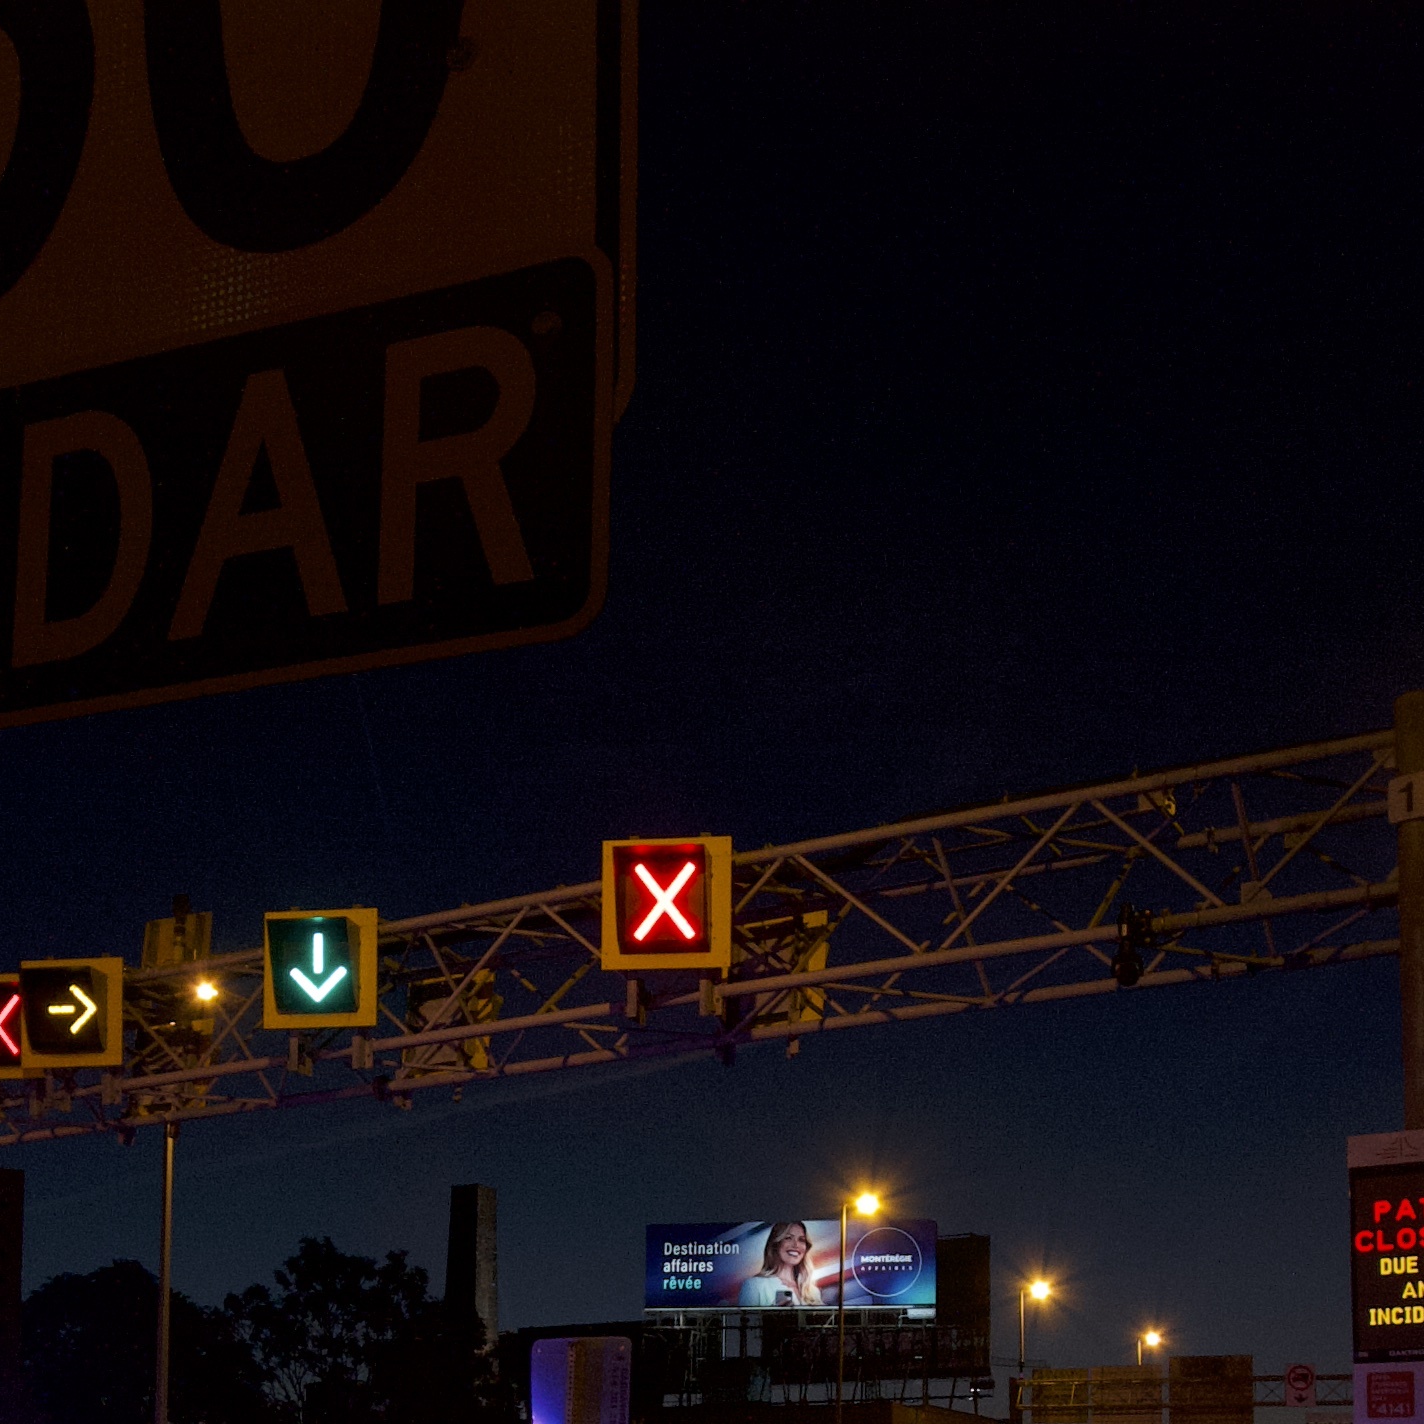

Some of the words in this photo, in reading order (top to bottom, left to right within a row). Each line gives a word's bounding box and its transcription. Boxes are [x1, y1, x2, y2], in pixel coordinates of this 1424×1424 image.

[1399, 781, 1414, 812] 1
[663, 1241, 740, 1256] Destination
[663, 1259, 714, 1273] affaires
[1379, 1255, 1419, 1275] DUE
[663, 1276, 702, 1290] rêvée
